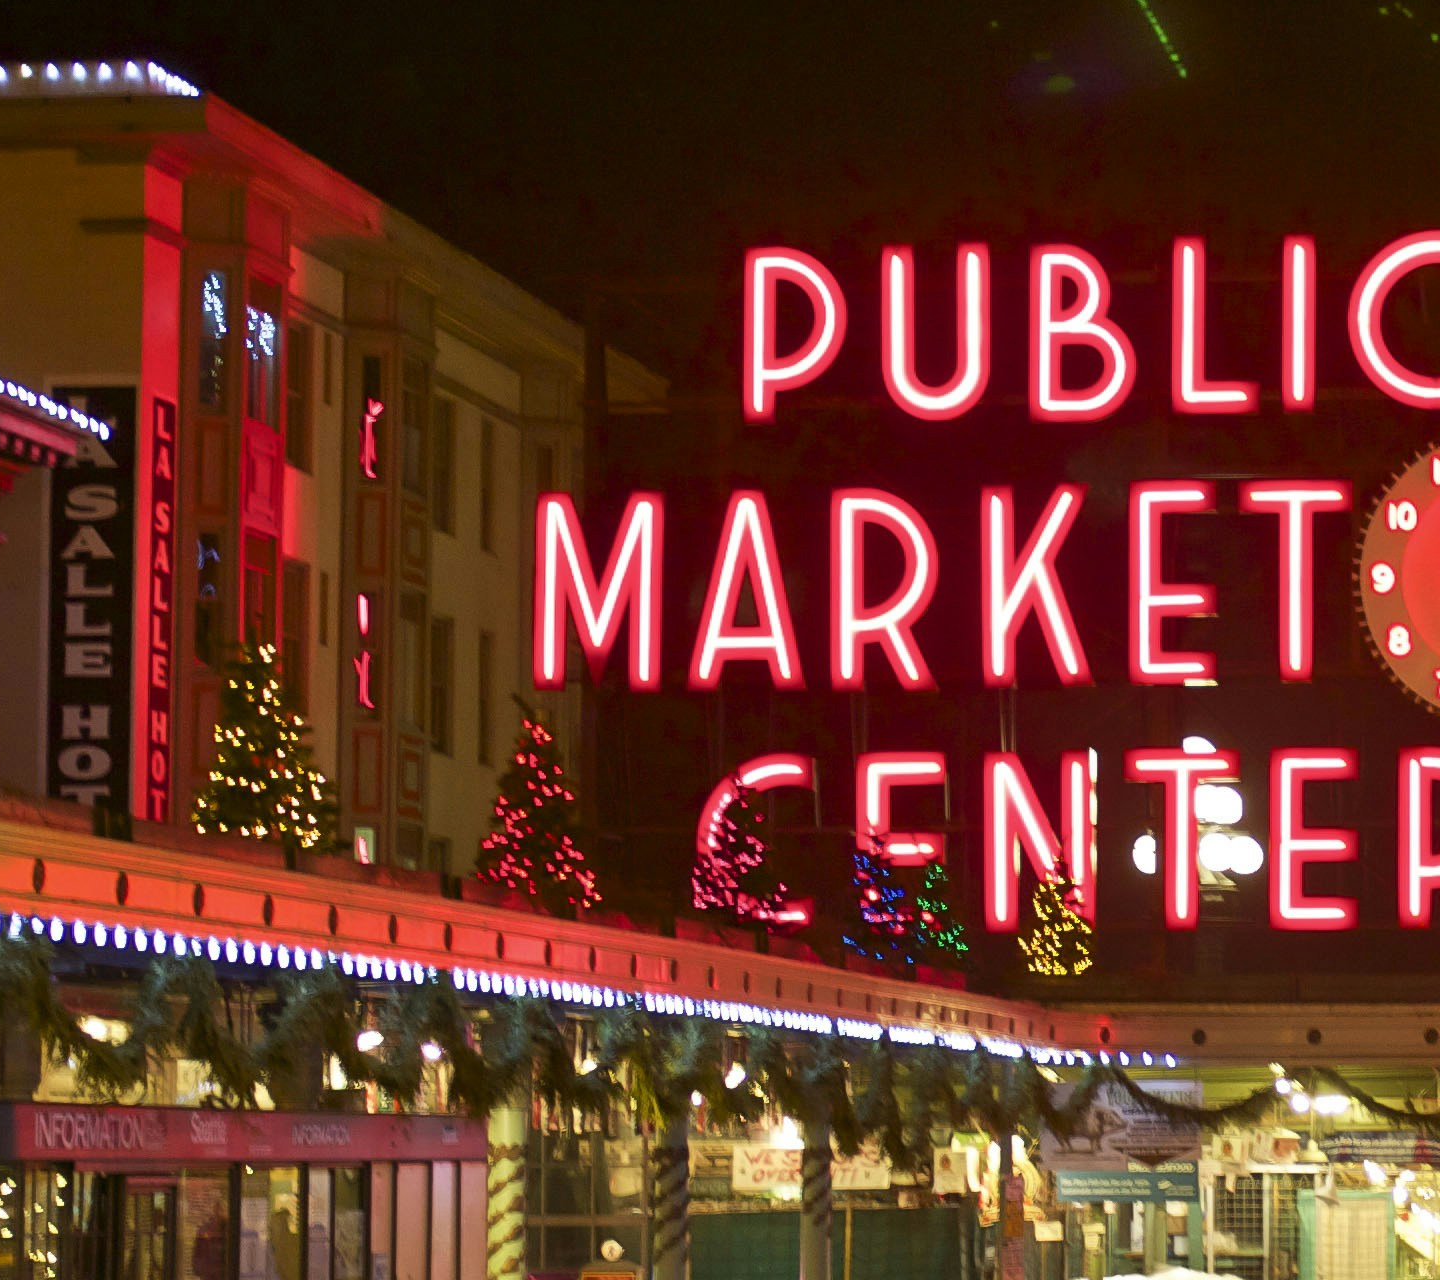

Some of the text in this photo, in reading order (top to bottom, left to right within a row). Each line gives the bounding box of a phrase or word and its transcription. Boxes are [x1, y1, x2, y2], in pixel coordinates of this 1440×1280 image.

[1385, 500, 1418, 532] 10
[58, 484, 120, 680] SALLE
[533, 478, 1352, 691] MARKET
[1370, 562, 1396, 595] 9
[148, 405, 174, 822] LA SALLE HOT
[1387, 624, 1412, 657] 8
[34, 1110, 146, 1150] INFORMATION
